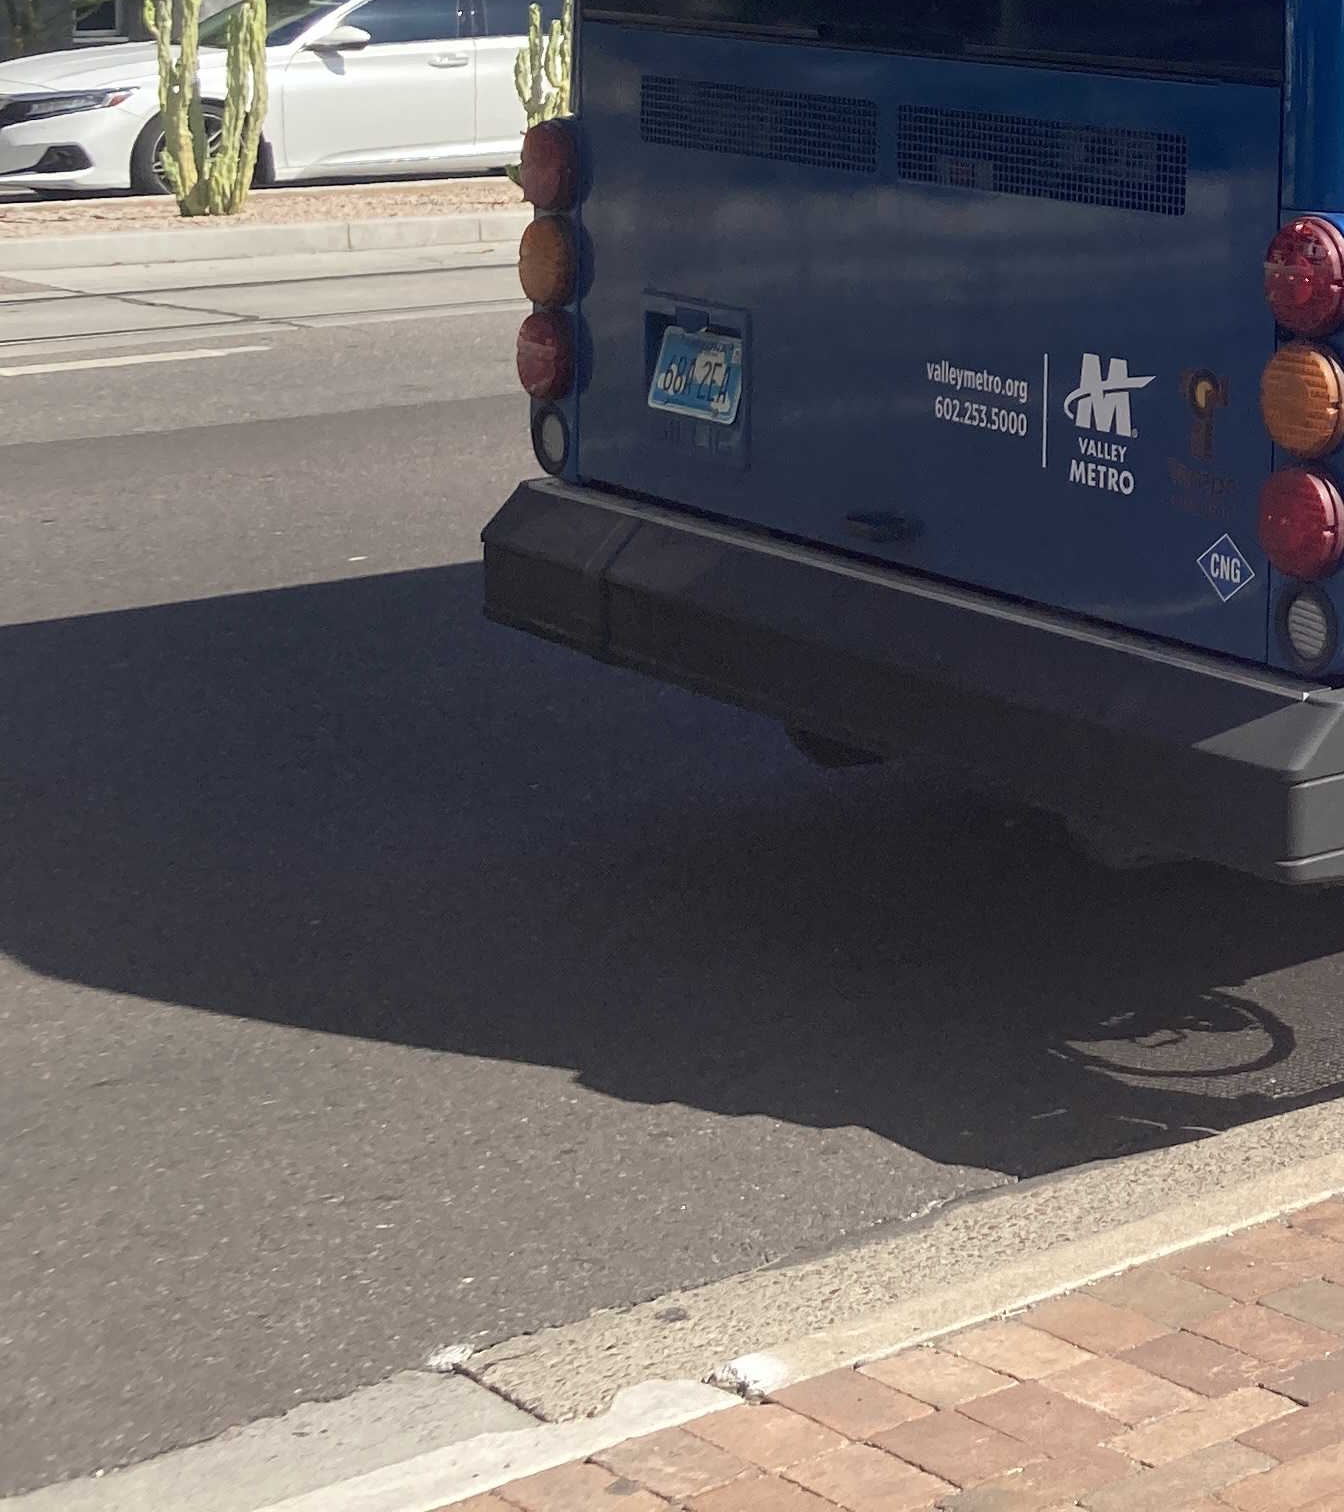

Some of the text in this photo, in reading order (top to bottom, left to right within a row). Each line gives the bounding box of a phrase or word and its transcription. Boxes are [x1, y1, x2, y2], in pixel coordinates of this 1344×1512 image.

[926, 359, 1029, 404] valleymetro.org
[935, 396, 1028, 436] 602.253.5000
[1078, 437, 1128, 463] VALLEY
[1069, 459, 1135, 495] METRO
[1210, 552, 1241, 584] CNG
